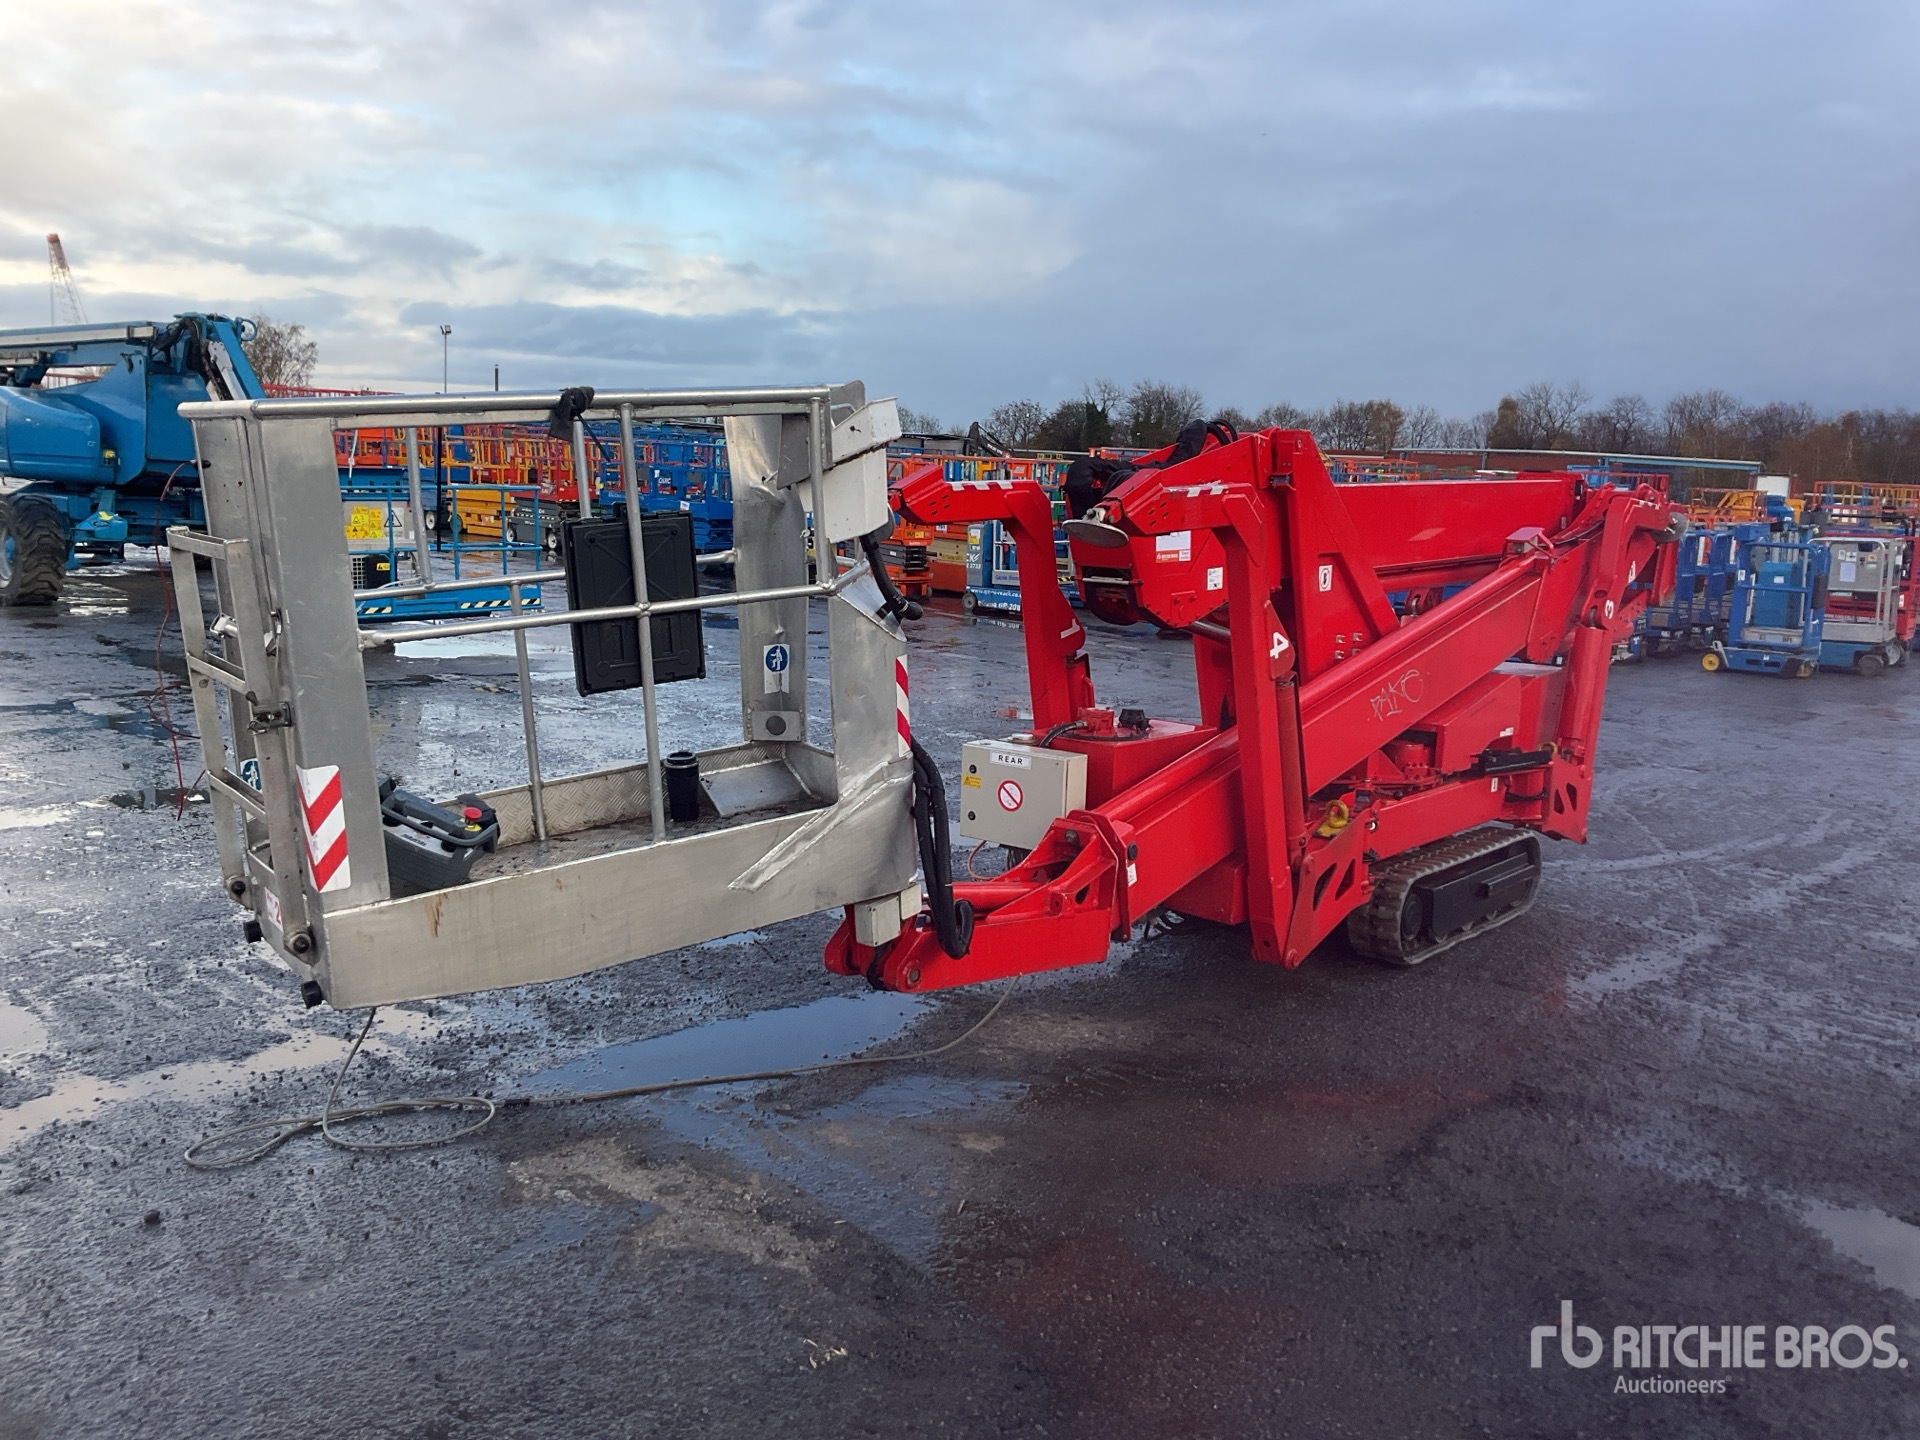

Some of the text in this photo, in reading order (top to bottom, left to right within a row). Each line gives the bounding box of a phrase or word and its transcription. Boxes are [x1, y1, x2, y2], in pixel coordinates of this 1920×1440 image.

[1604, 599, 1615, 620] 3
[1269, 631, 1290, 660] 4
[997, 754, 1023, 766] REAR
